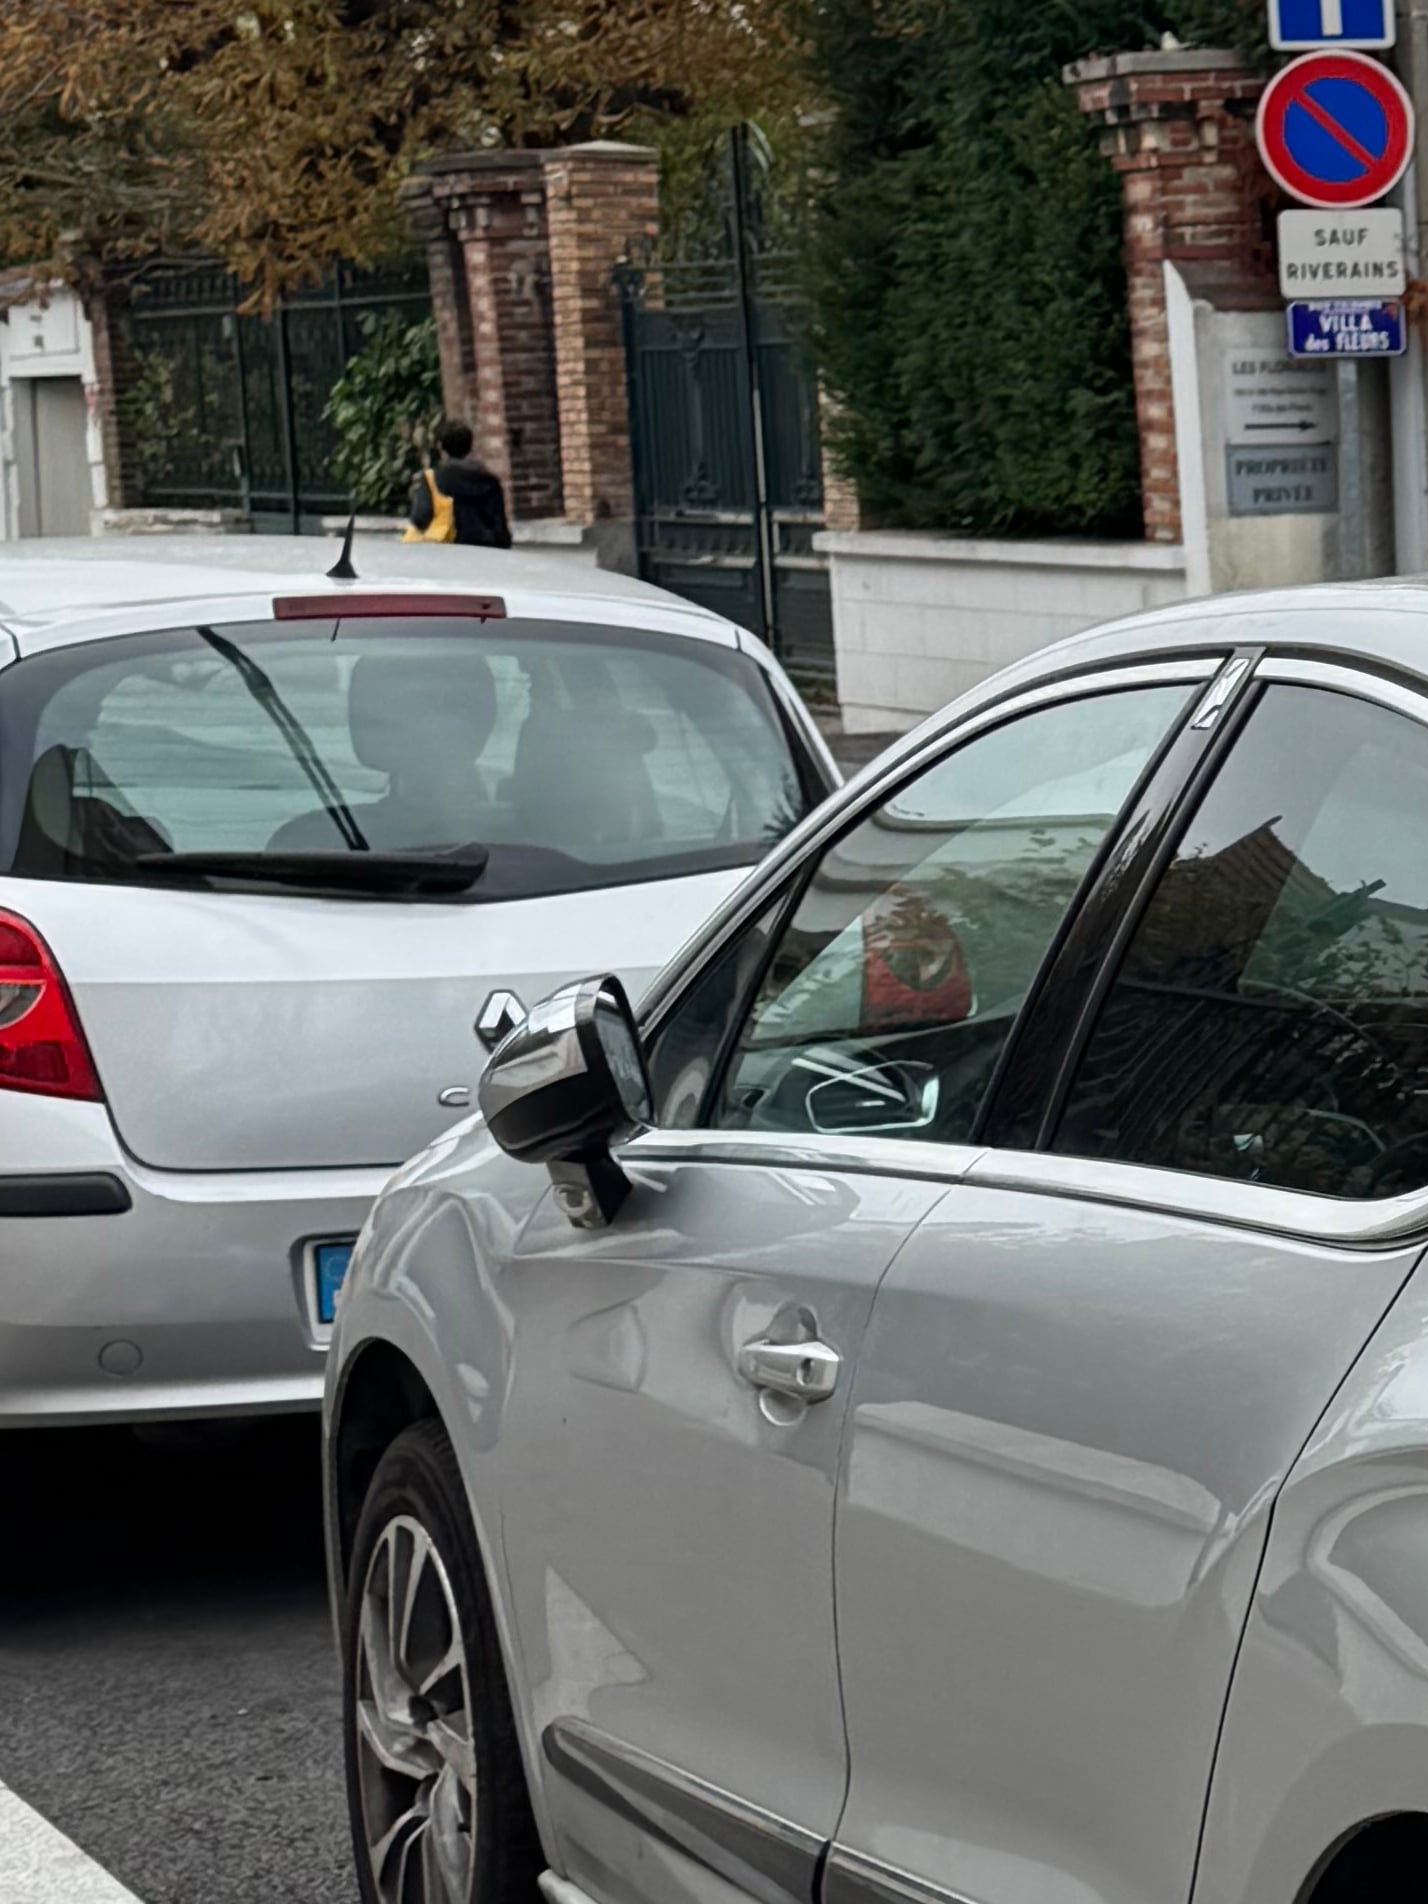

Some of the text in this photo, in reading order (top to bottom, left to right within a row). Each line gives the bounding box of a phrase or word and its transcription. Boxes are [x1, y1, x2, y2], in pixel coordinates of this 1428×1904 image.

[1314, 228, 1369, 247] SAUF
[1286, 261, 1399, 280] RIVERAINS
[1319, 313, 1373, 333] VILLA
